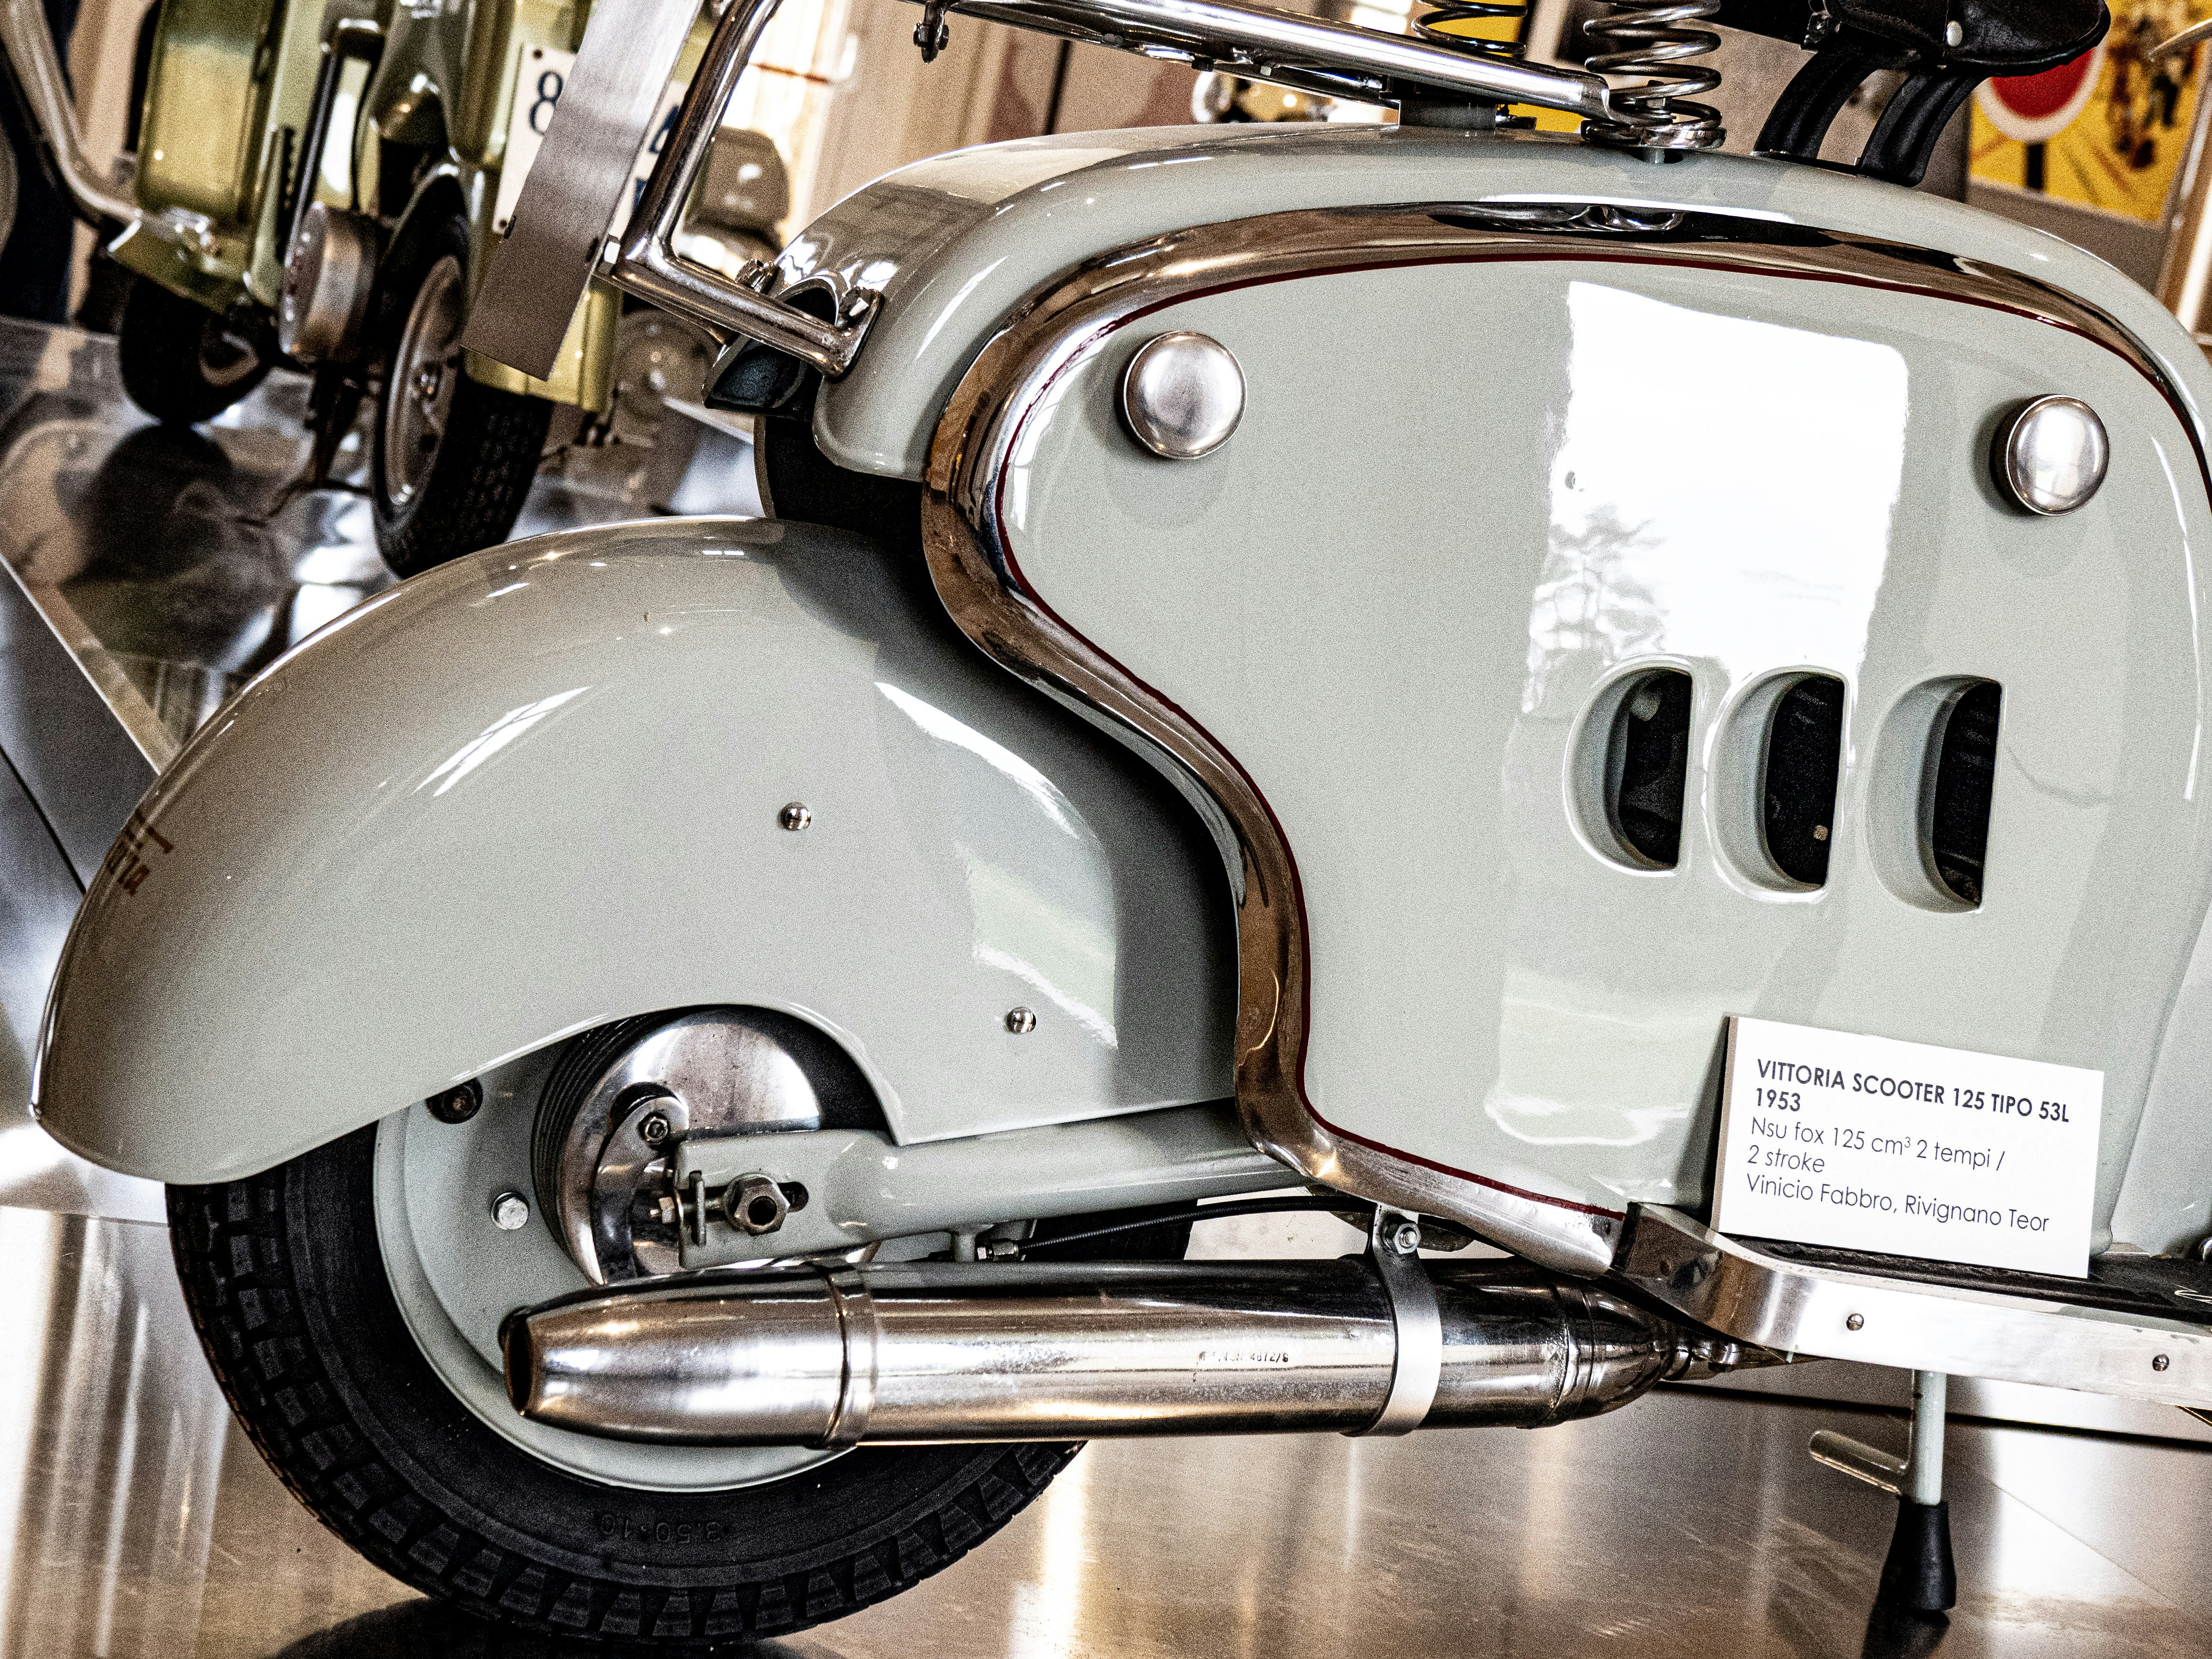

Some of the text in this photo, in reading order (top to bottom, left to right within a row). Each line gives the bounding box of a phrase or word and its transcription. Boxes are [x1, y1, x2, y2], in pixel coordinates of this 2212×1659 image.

[1756, 1088, 1800, 1111] 1953
[1758, 1059, 2069, 1122] VITTORIA SCOOTER 125 TIPO 53L
[1747, 1145, 1824, 1173] 2 stroke
[1752, 1117, 1786, 1138] Nsu
[1795, 1122, 1824, 1144] fox
[1834, 1128, 1864, 1149] 125
[1917, 1139, 1927, 1158] 2
[1935, 1142, 1990, 1170] tempi
[1996, 1151, 2005, 1171] /
[1747, 1174, 2049, 1231] Vinicio Fabbro, Rivignano Teor
